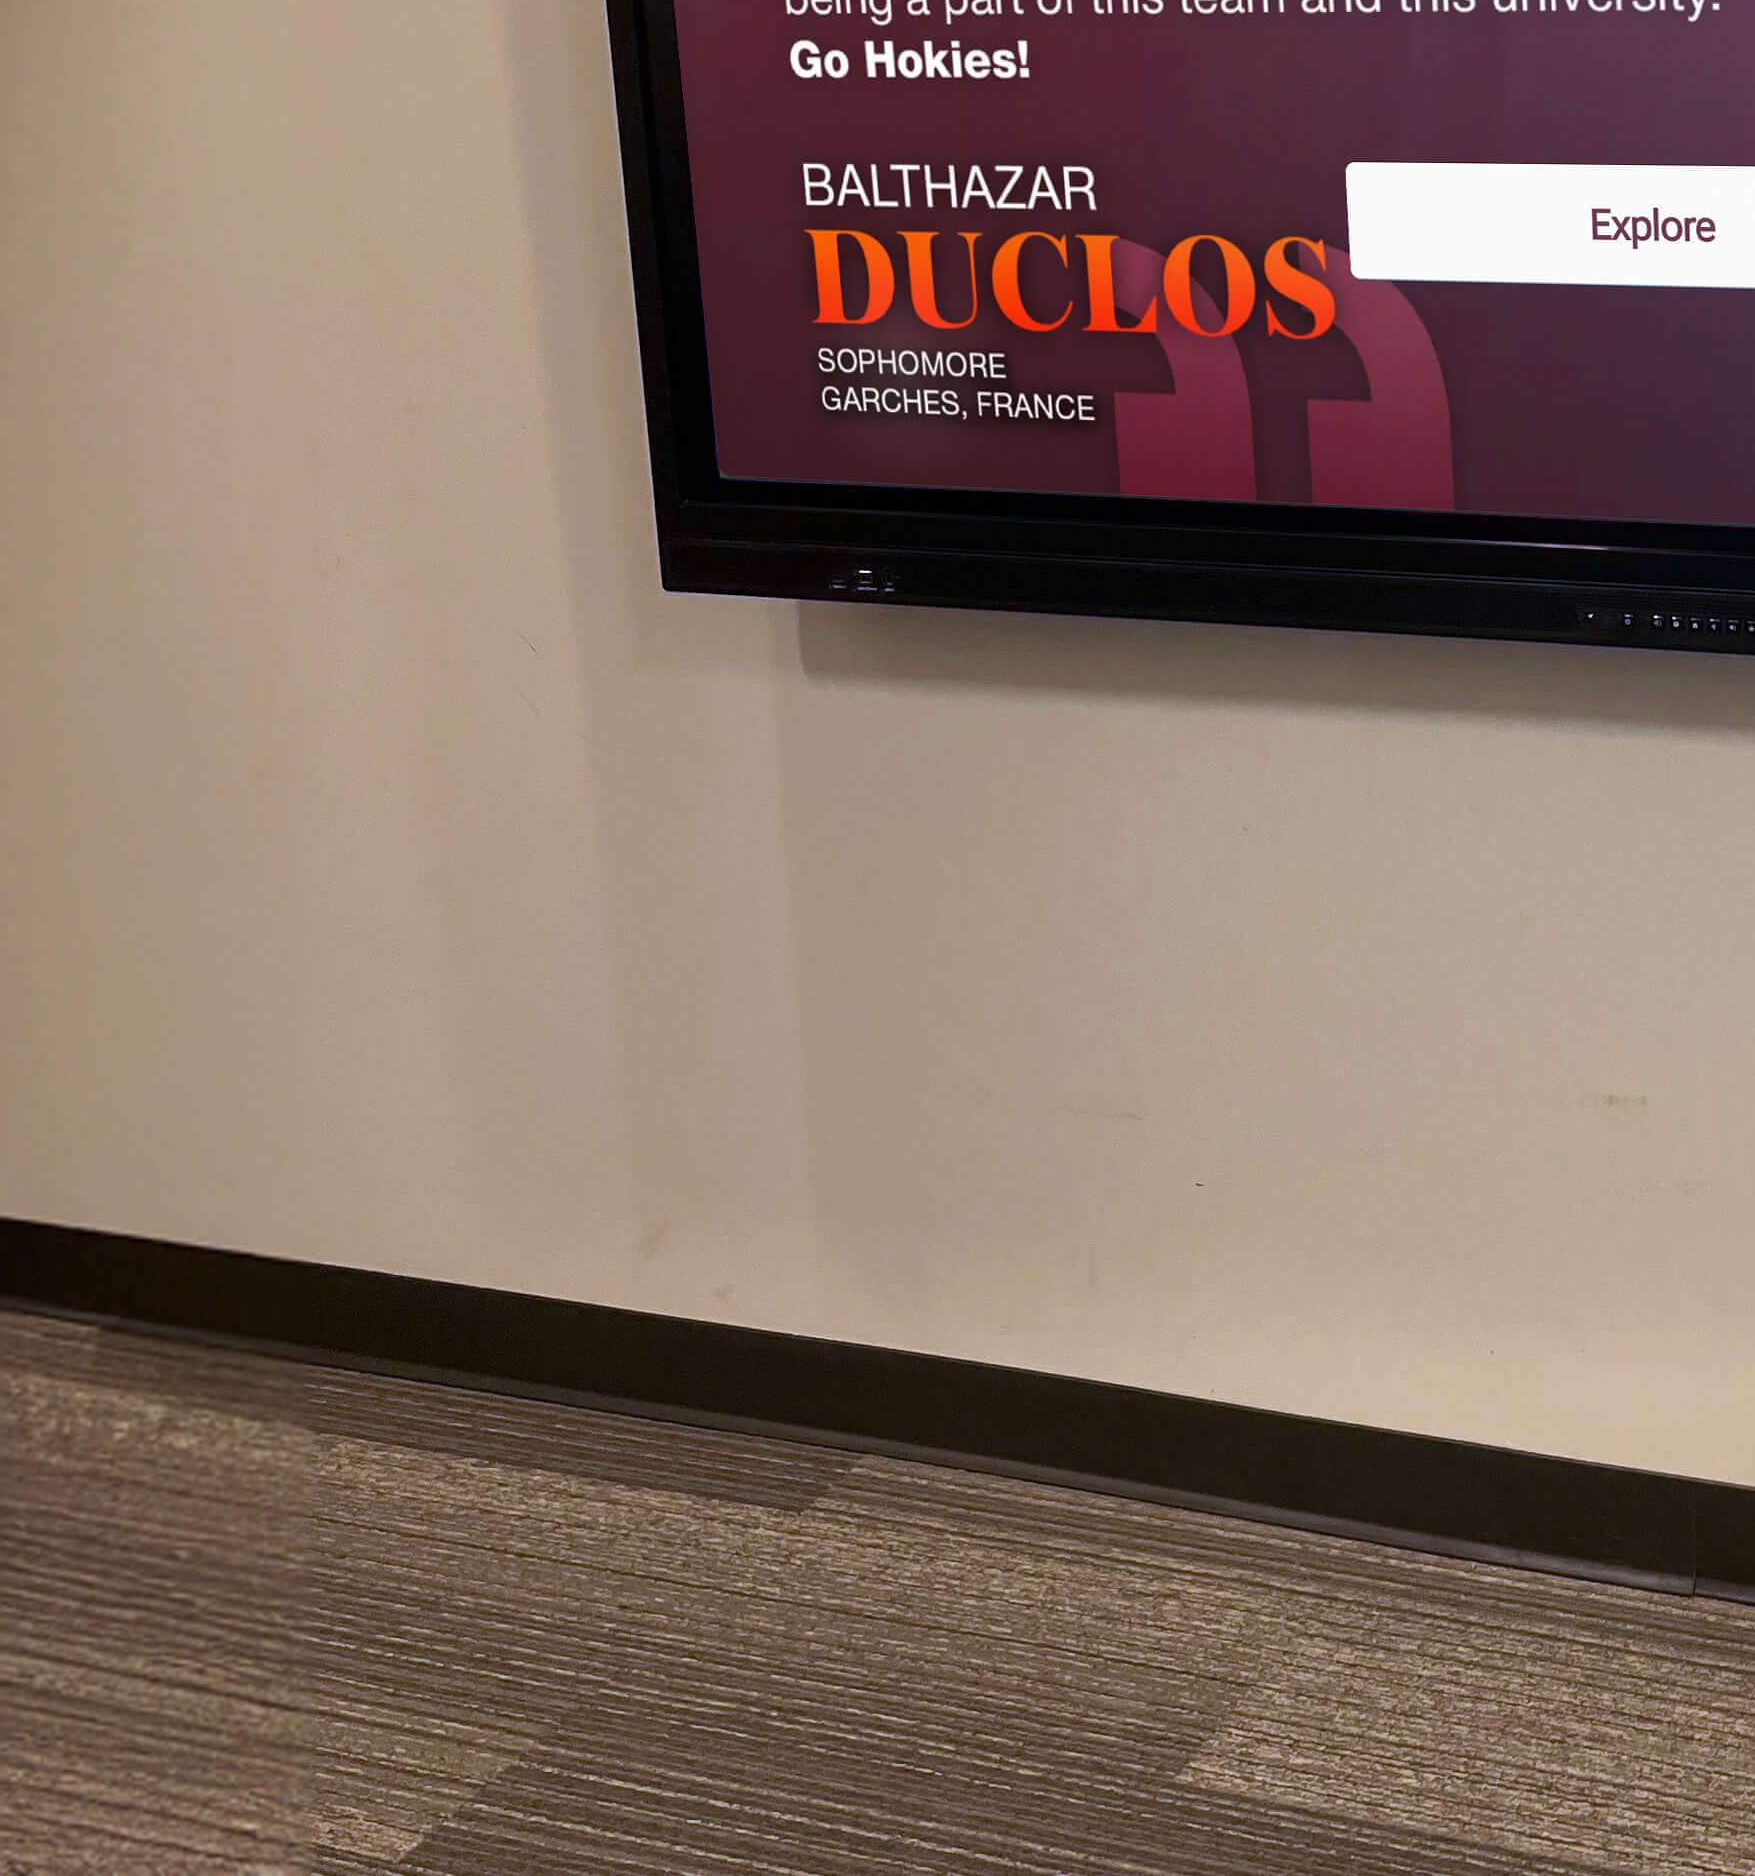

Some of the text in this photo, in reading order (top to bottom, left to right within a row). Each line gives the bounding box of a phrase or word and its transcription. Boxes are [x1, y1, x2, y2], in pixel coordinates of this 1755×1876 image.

[790, 40, 1029, 78] Go Hokies!
[803, 164, 1096, 210] BALTHAZAR
[1592, 208, 1715, 249] Explore
[805, 230, 1336, 339] DUCLOS
[819, 348, 1006, 378] SOPHOMORE
[822, 386, 1095, 420] GARCHES, FRANCE
